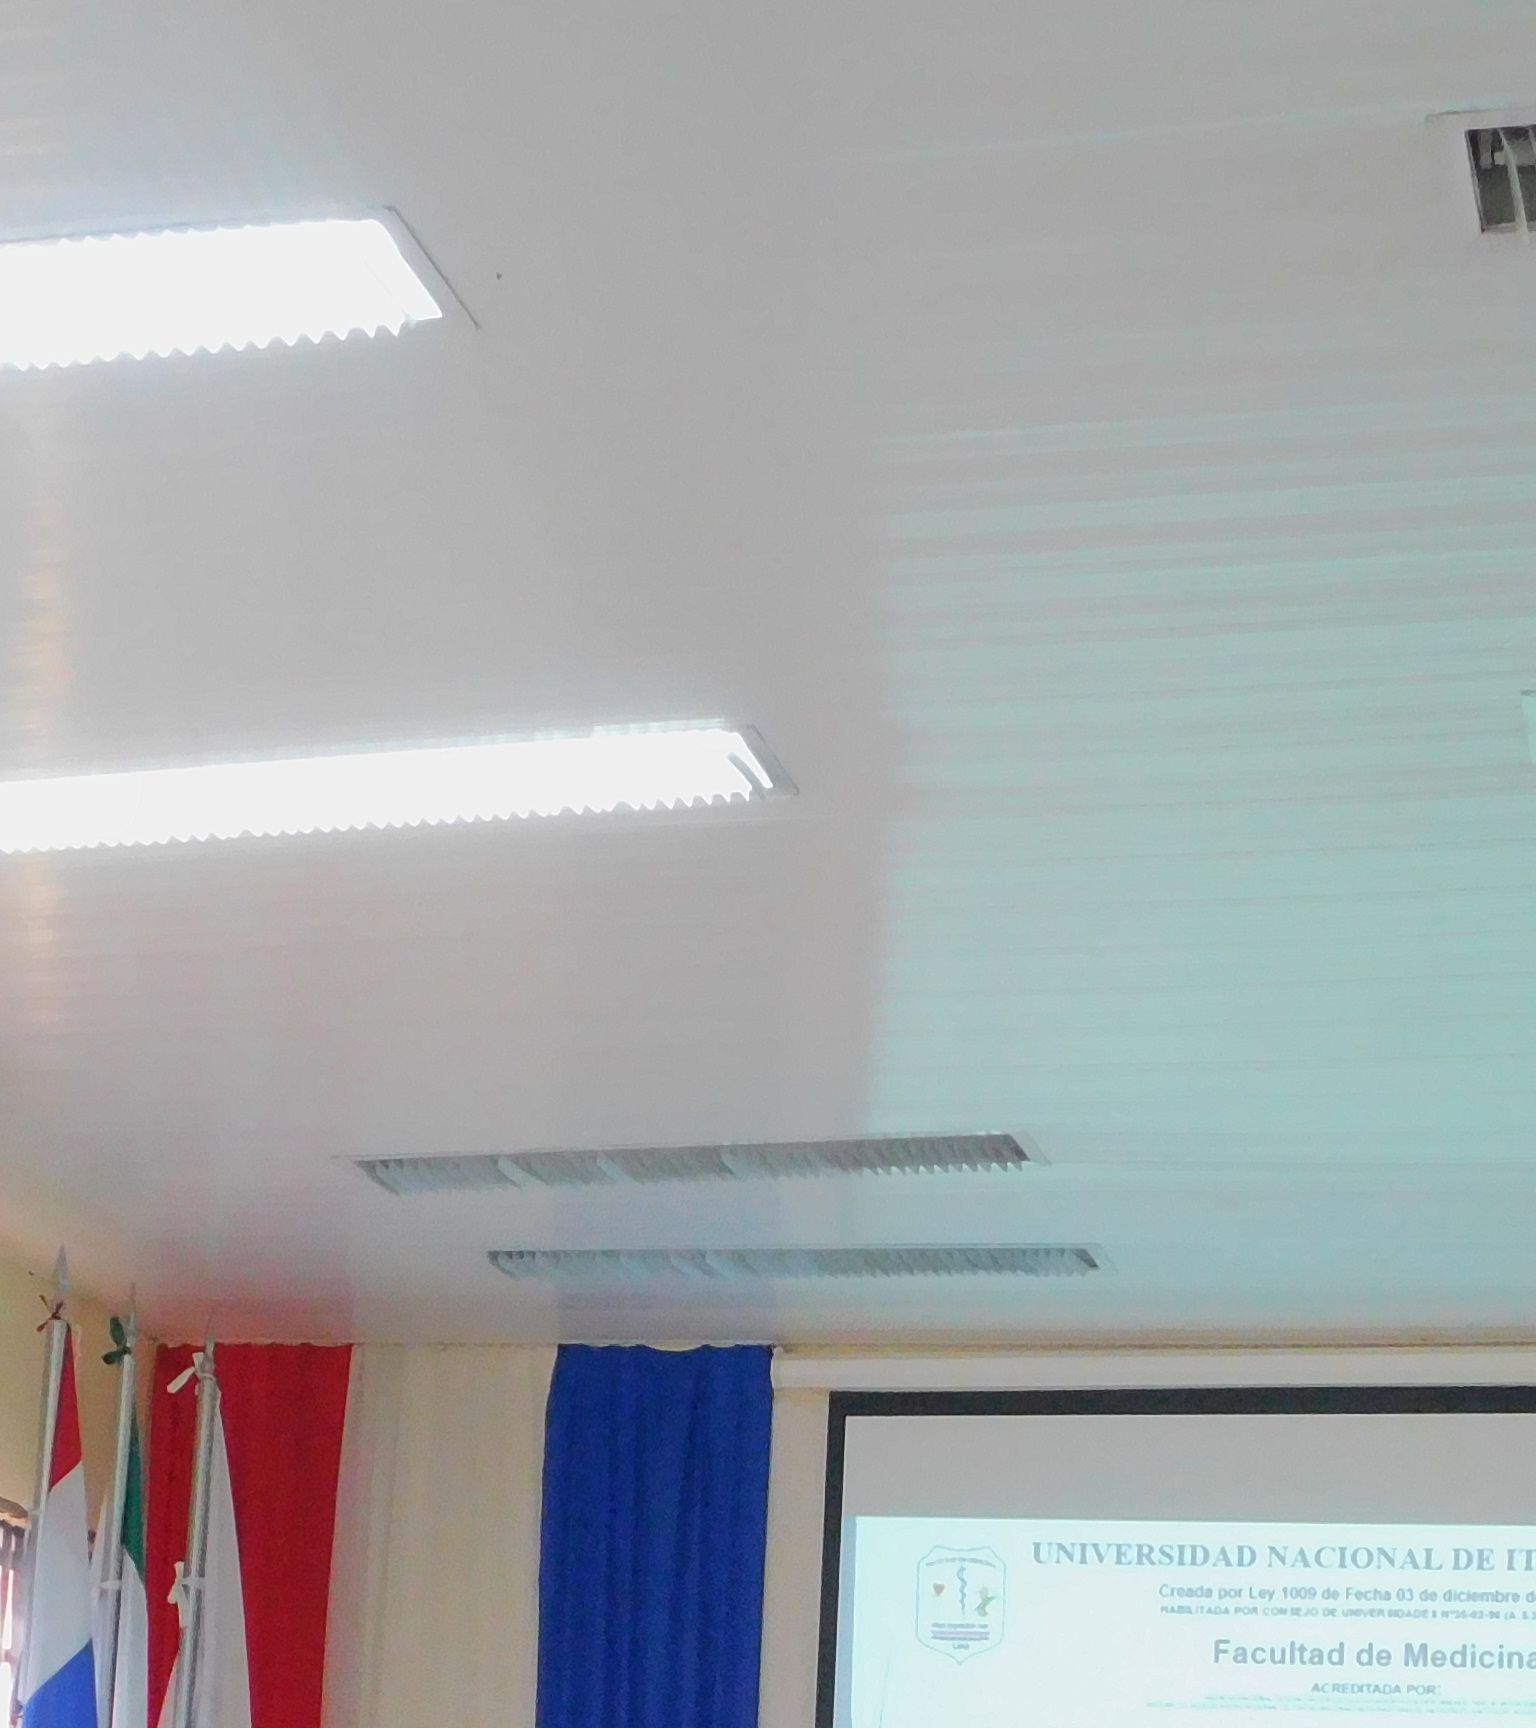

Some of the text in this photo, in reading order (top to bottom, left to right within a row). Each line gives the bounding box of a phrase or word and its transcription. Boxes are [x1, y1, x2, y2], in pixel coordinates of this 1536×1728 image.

[1032, 1542, 1257, 1568] UNIVERSIDAD
[1267, 1545, 1443, 1570] NACIONAL
[1451, 1547, 1495, 1571] DE
[1159, 1583, 1213, 1599] Creada
[1218, 1586, 1244, 1601] por
[1249, 1586, 1275, 1602] Ley
[1282, 1586, 1317, 1600] 1009
[1321, 1586, 1340, 1601] de
[1346, 1587, 1392, 1602] Fecha
[1396, 1588, 1414, 1602] 03
[1419, 1589, 1438, 1602] de
[1443, 1589, 1521, 1604] diciembre
[1234, 1606, 1259, 1616] POR
[1322, 1607, 1338, 1617] DE
[1213, 1639, 1345, 1666] Facultad
[1355, 1642, 1393, 1667] de
[1311, 1682, 1402, 1696] ACREDITADA
